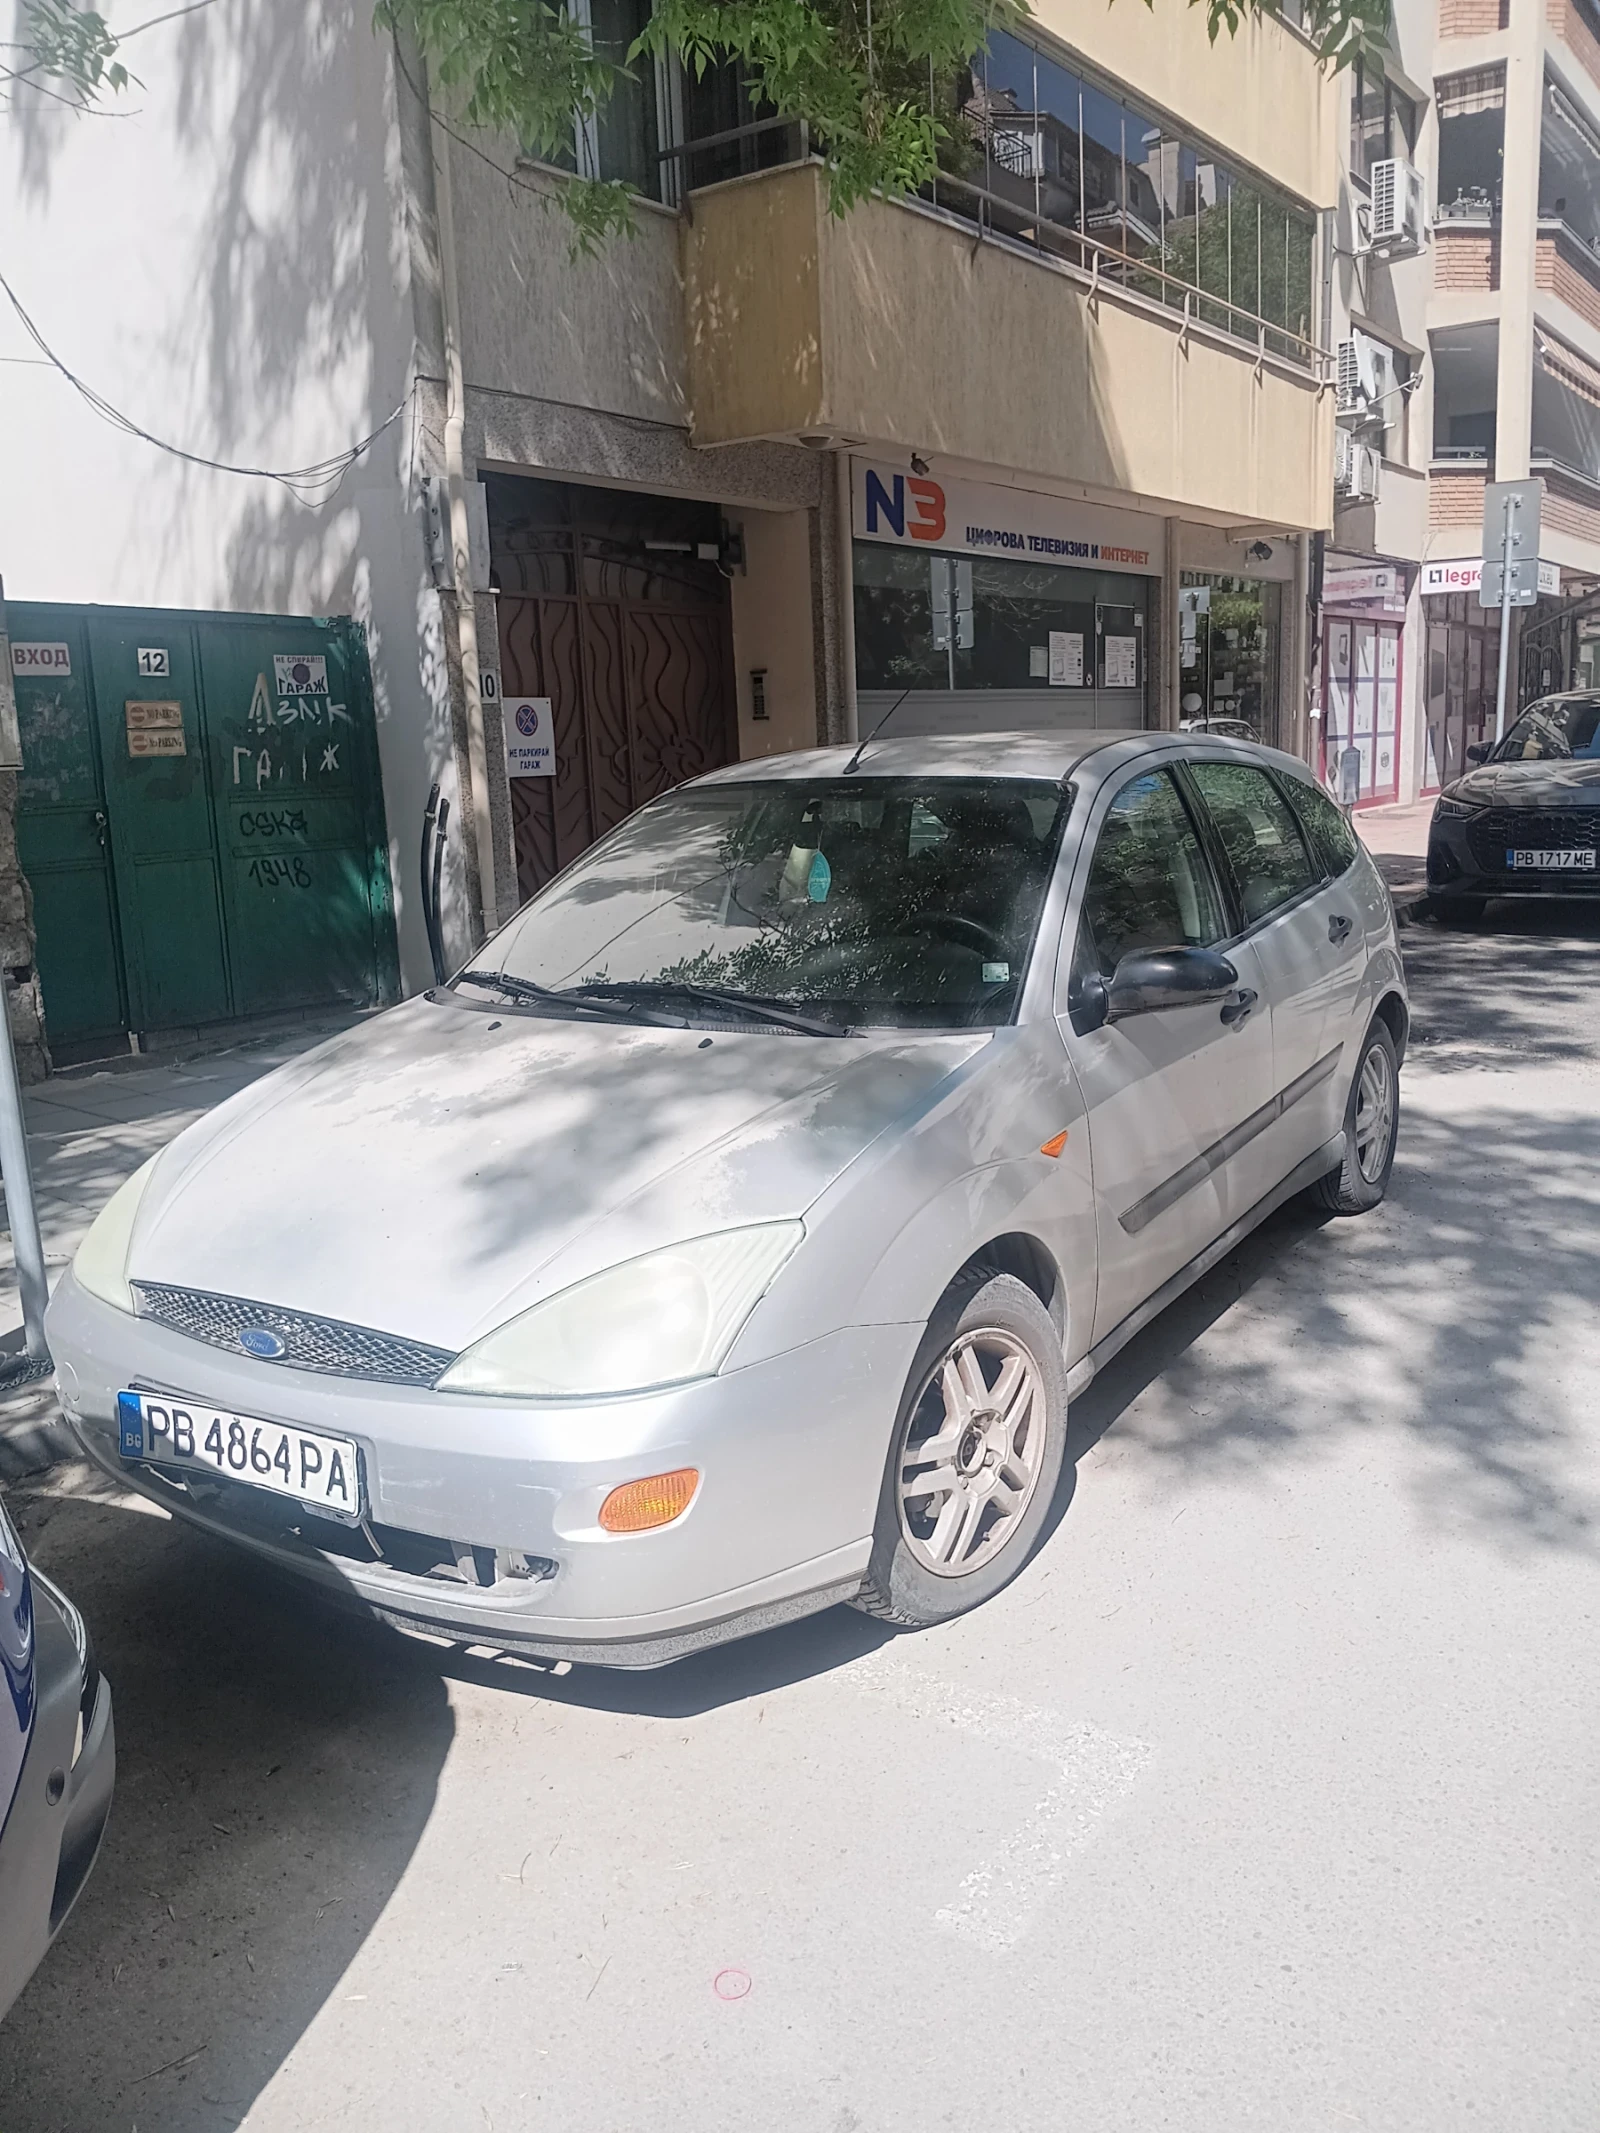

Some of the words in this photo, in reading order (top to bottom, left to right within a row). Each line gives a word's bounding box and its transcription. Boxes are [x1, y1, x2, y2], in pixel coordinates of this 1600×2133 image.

[966, 526, 1025, 550] ЦИФРОВА
[1027, 535, 1089, 558] ТЕЛЕВИЗИЯ
[1091, 544, 1099, 559] И
[1100, 546, 1149, 565] ИНТЕРНЕТ
[14, 649, 69, 668] ВХОД
[142, 652, 166, 673] 12
[278, 676, 326, 694] ГАРАЖ
[509, 748, 518, 758] НЕ
[519, 746, 550, 758] ПАРКИРАЙ
[520, 760, 541, 770] ГАРАЖ
[248, 857, 311, 888] 1948
[246, 1332, 271, 1351] Ford
[125, 1431, 142, 1448] BG
